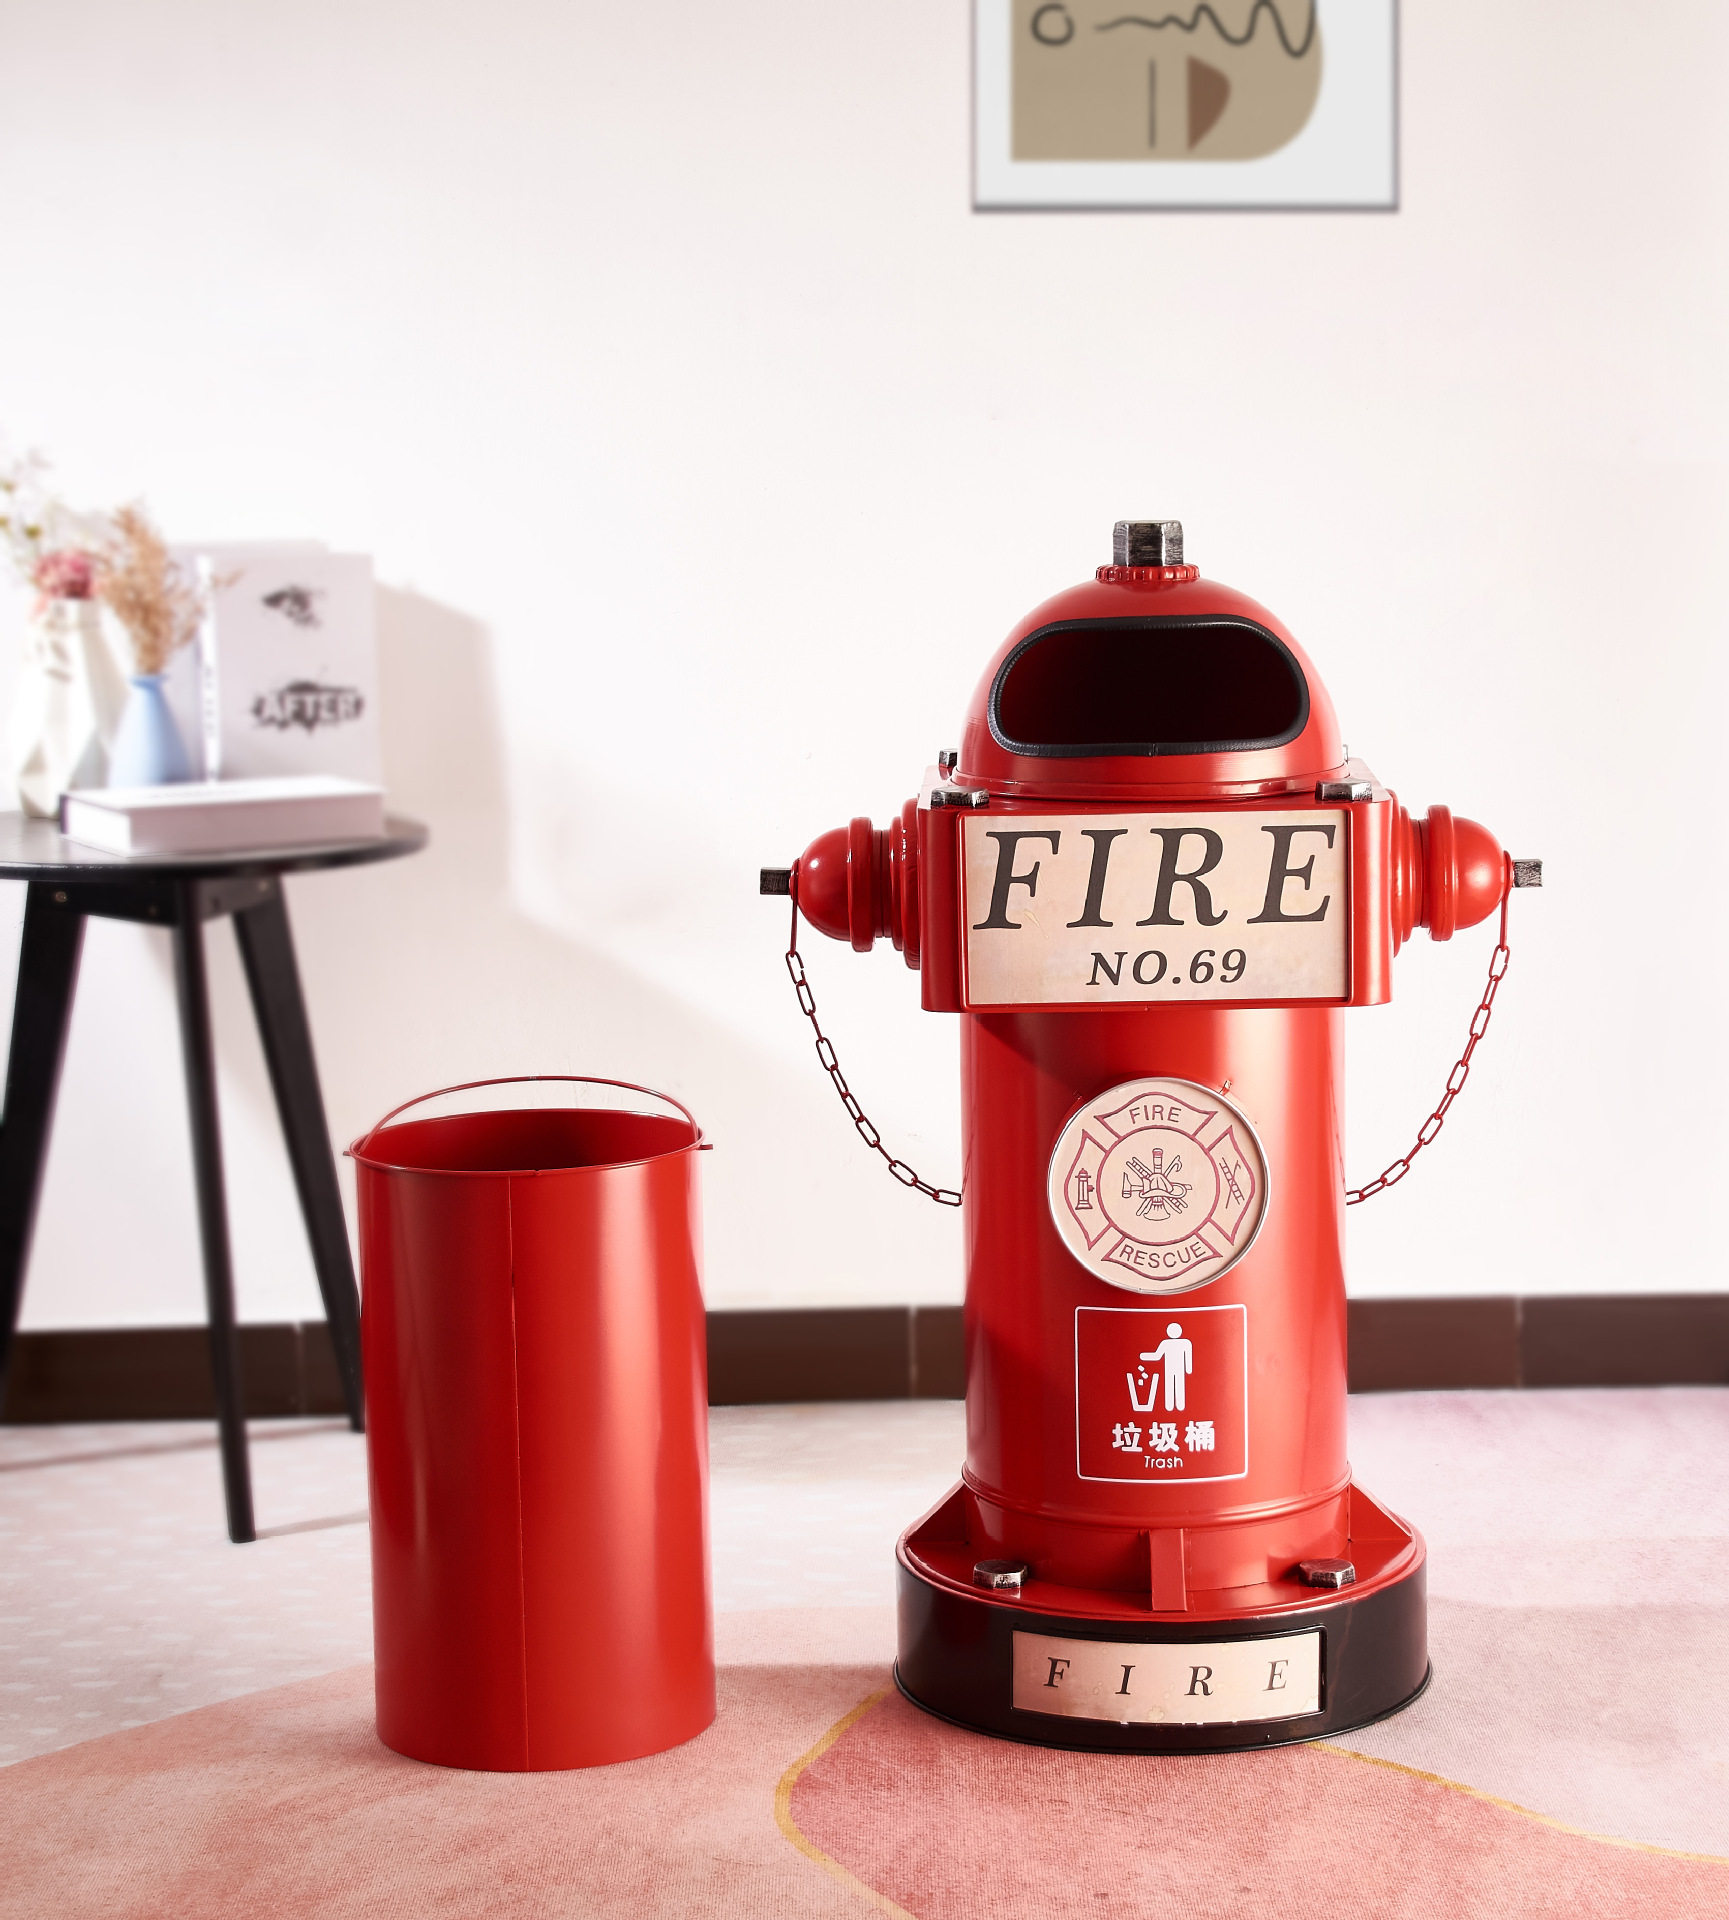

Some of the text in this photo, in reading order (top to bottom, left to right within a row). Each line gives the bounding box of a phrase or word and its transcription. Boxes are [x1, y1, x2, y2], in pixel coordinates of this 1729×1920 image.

[973, 825, 1336, 930] FIRE
[1086, 949, 1247, 986] NO.69
[1128, 1104, 1182, 1125] FIRE
[1119, 1241, 1206, 1269] RESCUE
[1112, 1420, 1215, 1453] 垃圾桶
[1144, 1455, 1184, 1469] Trash
[1043, 1656, 1289, 1696] FIRE
